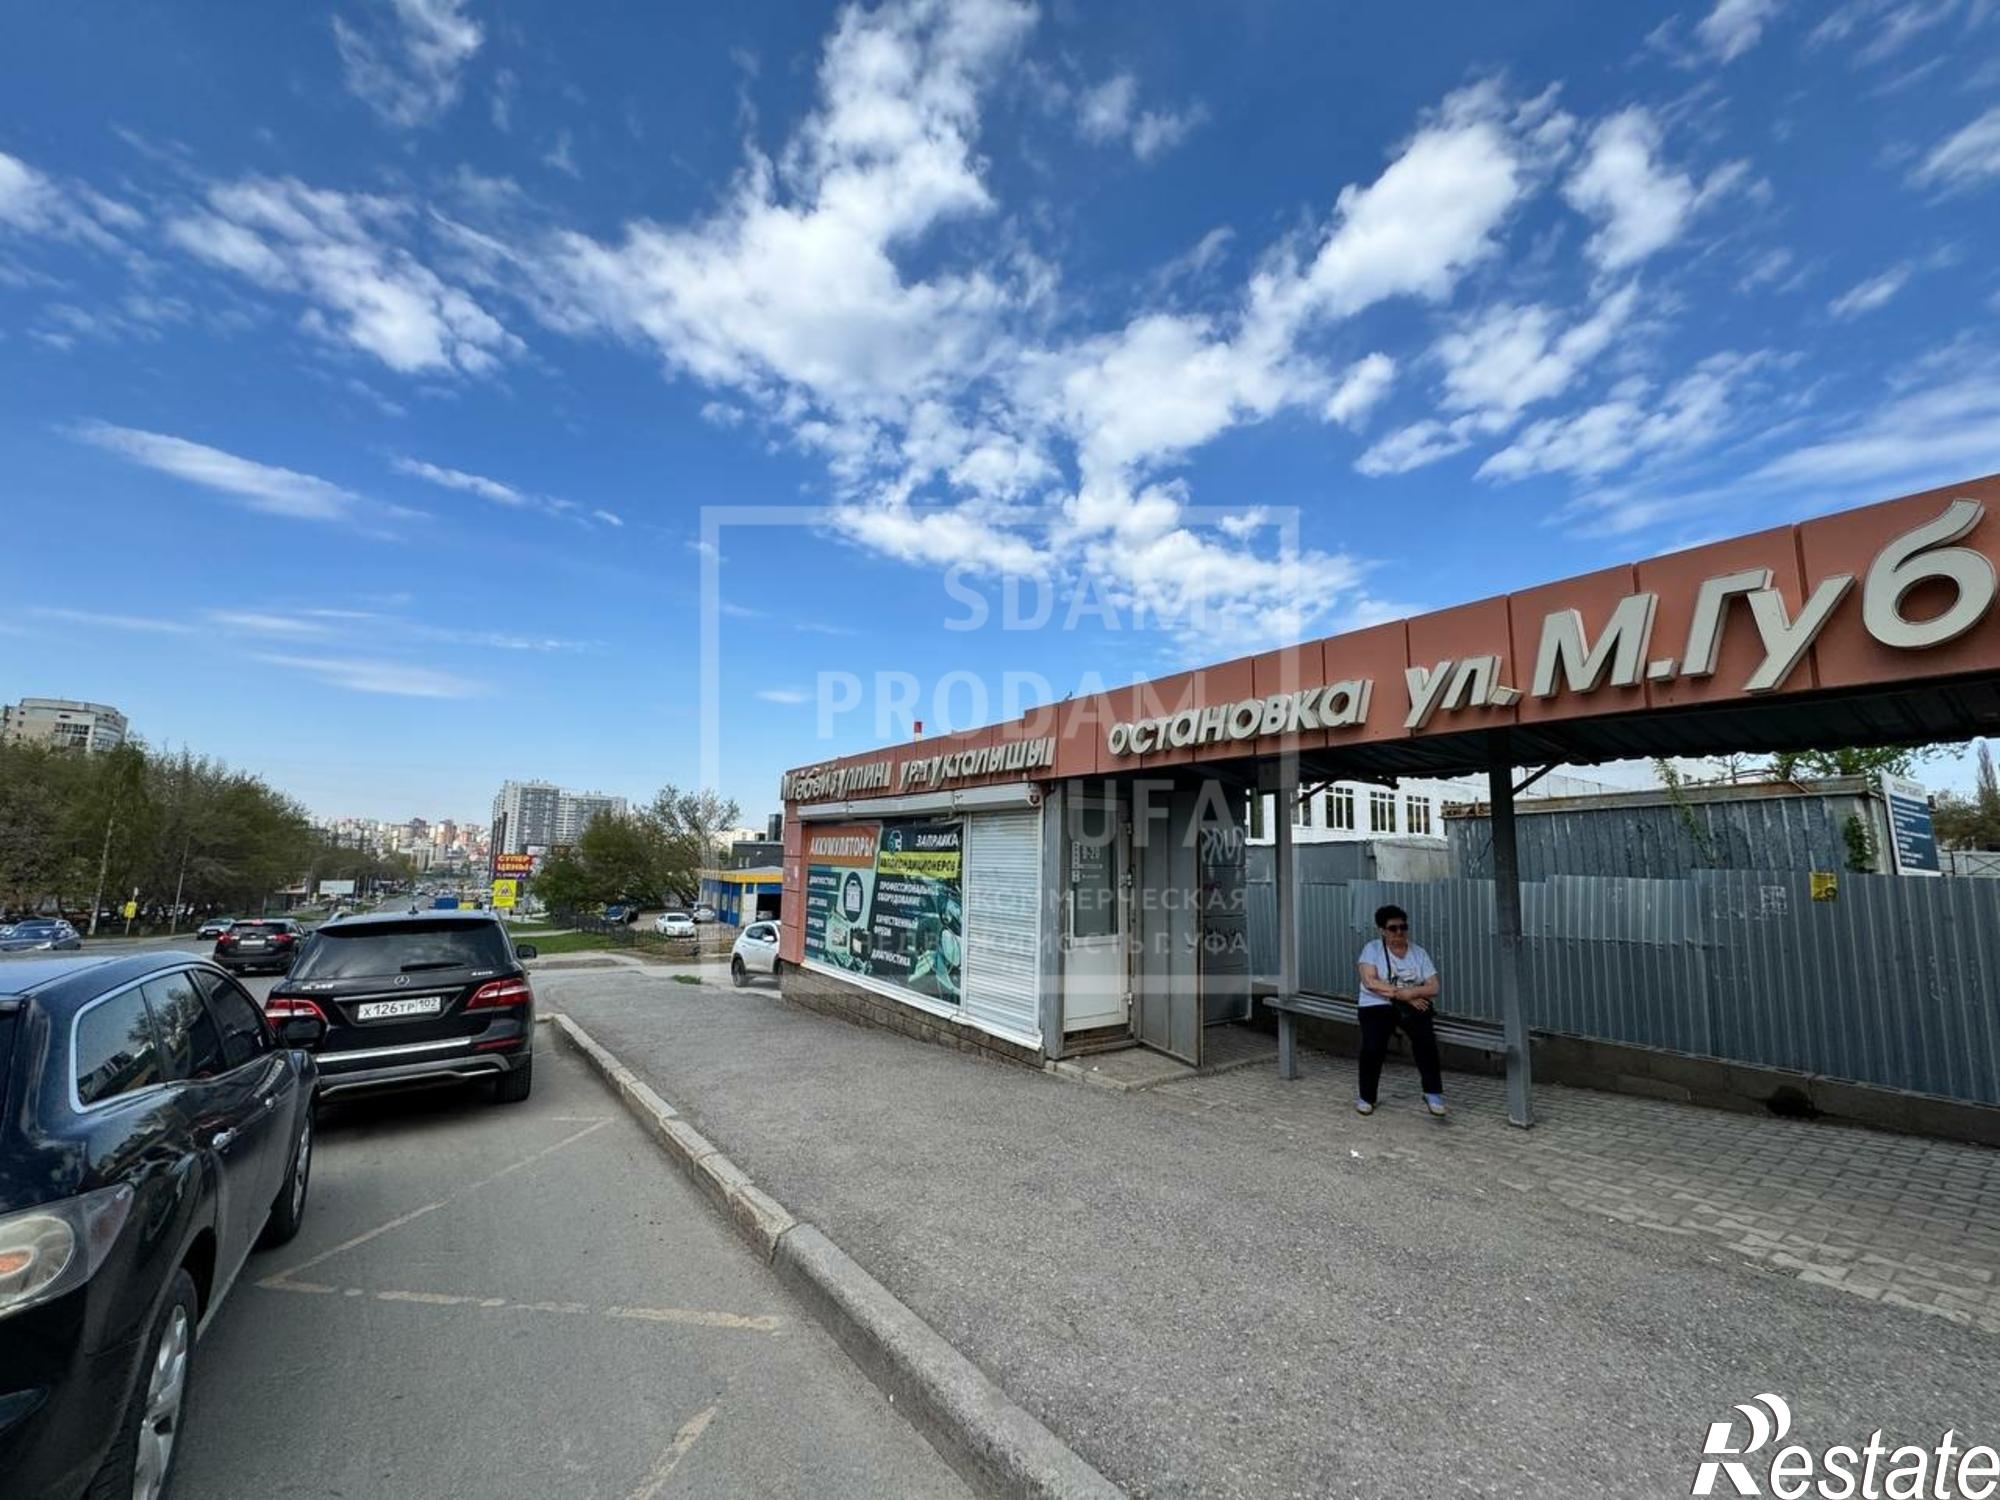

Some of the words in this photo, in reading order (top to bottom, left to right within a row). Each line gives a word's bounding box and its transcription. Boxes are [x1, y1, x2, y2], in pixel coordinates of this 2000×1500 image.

[1108, 679, 1375, 755] остановка
[1404, 654, 1524, 732] ул.
[1530, 498, 1998, 699] М.Губ
[809, 836, 874, 857] АККУМУЛЯТОРЫ
